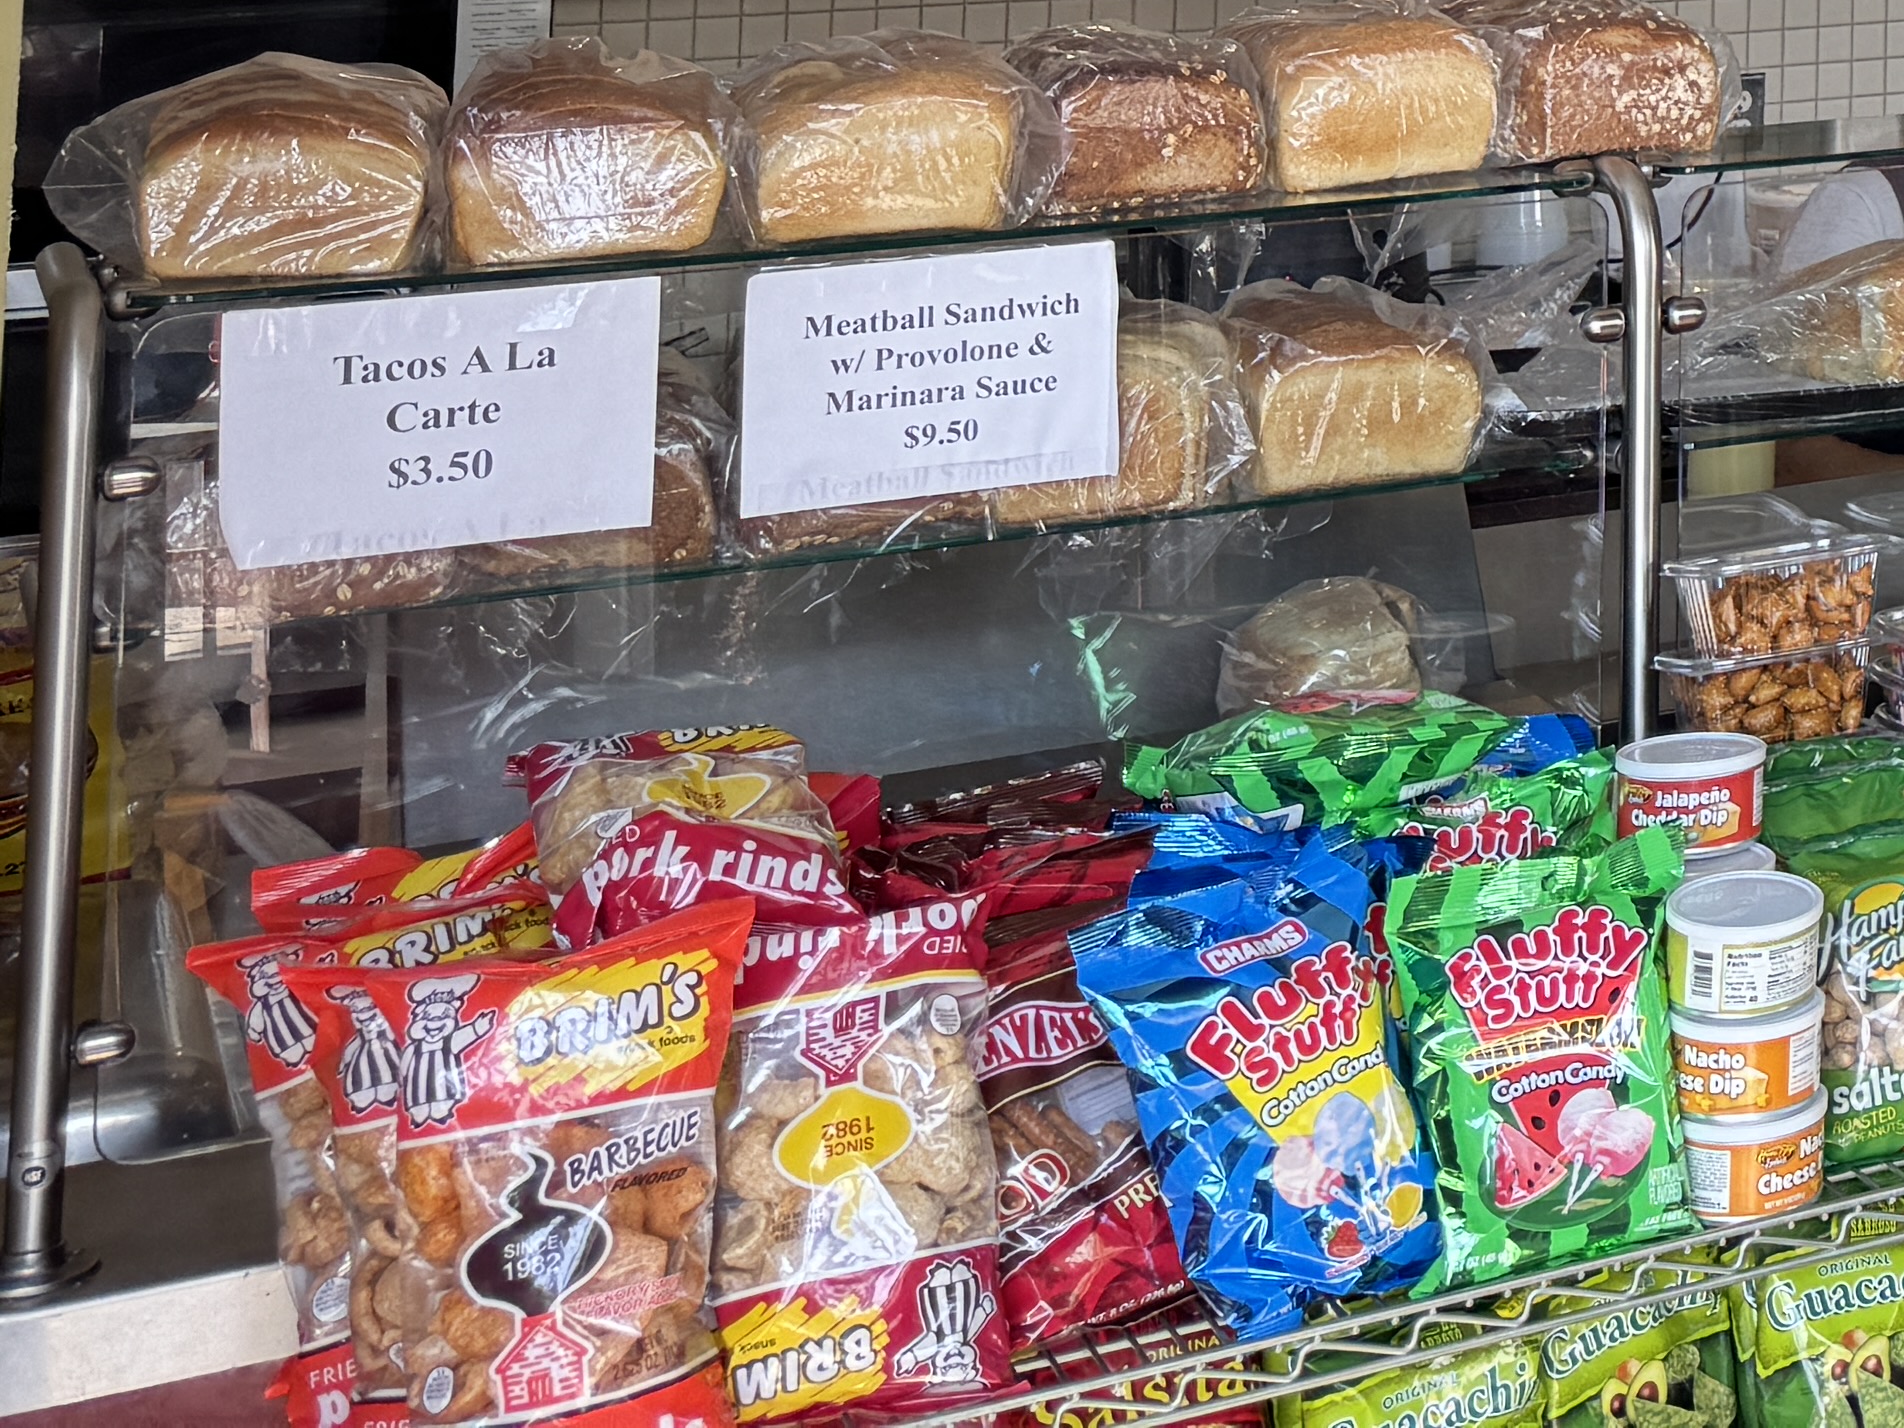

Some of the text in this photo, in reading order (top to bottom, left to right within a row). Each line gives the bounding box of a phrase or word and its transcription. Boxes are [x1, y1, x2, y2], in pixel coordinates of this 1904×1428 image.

[803, 293, 1081, 340] Meatball Sandwich
[332, 341, 558, 388] Tacos A La
[830, 332, 1053, 377] w/ Provolone &
[824, 372, 1059, 416] Marinara Sauce
[386, 398, 502, 434] Carte
[903, 418, 979, 451] $9.50
[387, 449, 494, 491] $3.50
[1654, 786, 1731, 808] Jalapeño
[1700, 807, 1728, 826] Dip
[582, 831, 846, 907] pork rinds
[1207, 926, 1304, 970] CHARMS
[513, 962, 702, 1067] BRIM'S
[1684, 1044, 1745, 1069] Nacho
[821, 1116, 875, 1139] 1982
[1833, 1105, 1896, 1134] ROASTED
[1854, 1119, 1904, 1144] PEANUTS
[566, 1110, 699, 1190] BARBECUE
[824, 1137, 874, 1159] SINCE
[611, 1168, 688, 1193] FLAVORED
[503, 1235, 559, 1258] SINCE
[502, 1252, 561, 1280] 1982
[1817, 1254, 1891, 1277] ORIGINAL
